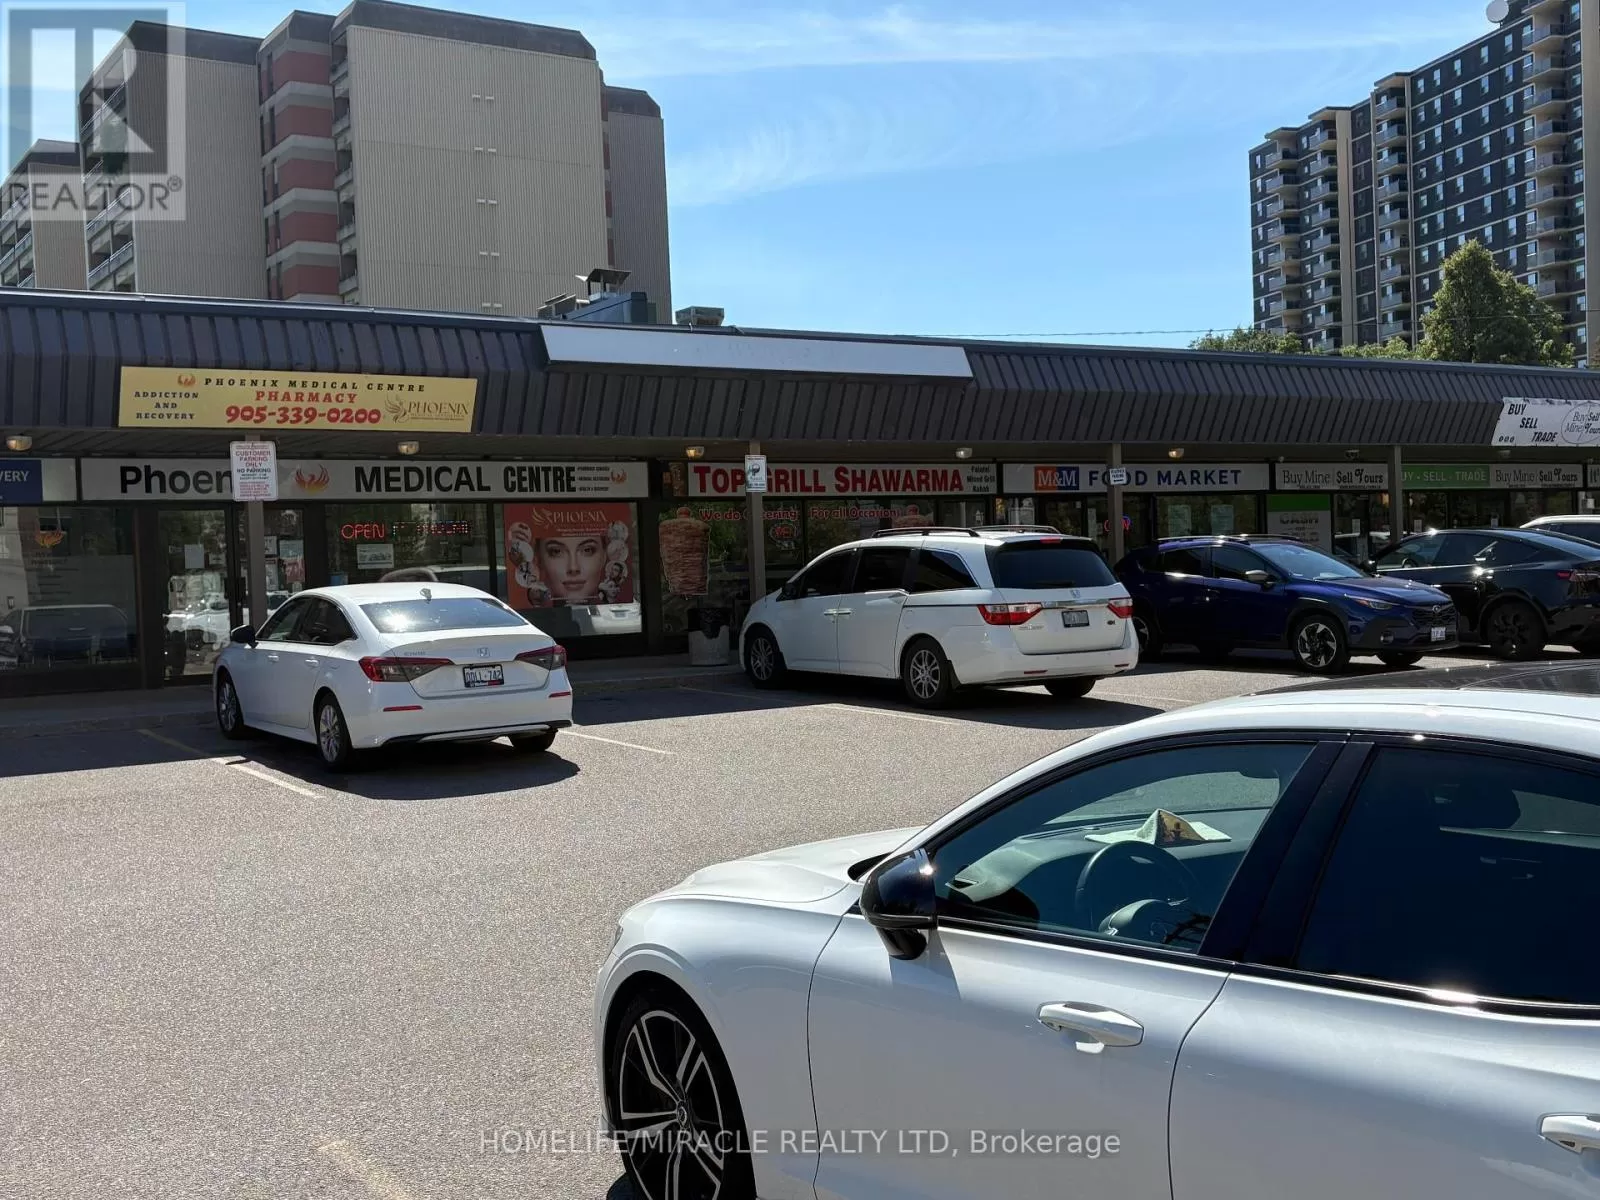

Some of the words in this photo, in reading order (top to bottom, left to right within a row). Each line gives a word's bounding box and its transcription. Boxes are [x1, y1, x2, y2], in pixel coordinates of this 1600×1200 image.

[204, 377, 280, 388] PHOENIX
[288, 379, 358, 391] MEDICAL
[366, 381, 426, 392] CENTRE
[134, 391, 199, 399] ADDICTION
[255, 390, 358, 404] PHARMACY
[225, 405, 382, 425] 905-339-0200
[408, 400, 470, 416] PHOENIX
[1507, 403, 1527, 415] BUY
[136, 412, 195, 420] RECOVERY
[1519, 417, 1538, 429] SELL
[1584, 422, 1600, 434] Your
[1531, 431, 1558, 443] TRADE
[120, 465, 232, 494] Phoen
[354, 466, 492, 493] MEDICAL
[503, 466, 577, 493] CENTRE
[693, 465, 745, 493] TOP
[834, 467, 964, 493] SHAWARMA
[1037, 470, 1078, 487] M&M
[1157, 469, 1242, 486] MARKET
[1283, 470, 1303, 487] Buy
[1303, 470, 1330, 484] Mine
[1336, 470, 1354, 484] Sell
[1354, 468, 1384, 484] Yours
[1400, 471, 1414, 482] UY
[1423, 471, 1447, 482] SELL
[1455, 471, 1487, 482] TRADE
[1495, 469, 1513, 483] Buy
[1513, 470, 1535, 482] Mine
[1538, 470, 1553, 482] Sell
[1553, 468, 1578, 482] Yours
[552, 510, 608, 523] PHOENIX
[699, 508, 721, 521] We
[809, 507, 829, 520] For
[831, 506, 848, 520] all
[849, 506, 901, 521] Occasion
[341, 523, 385, 541] OPEN
